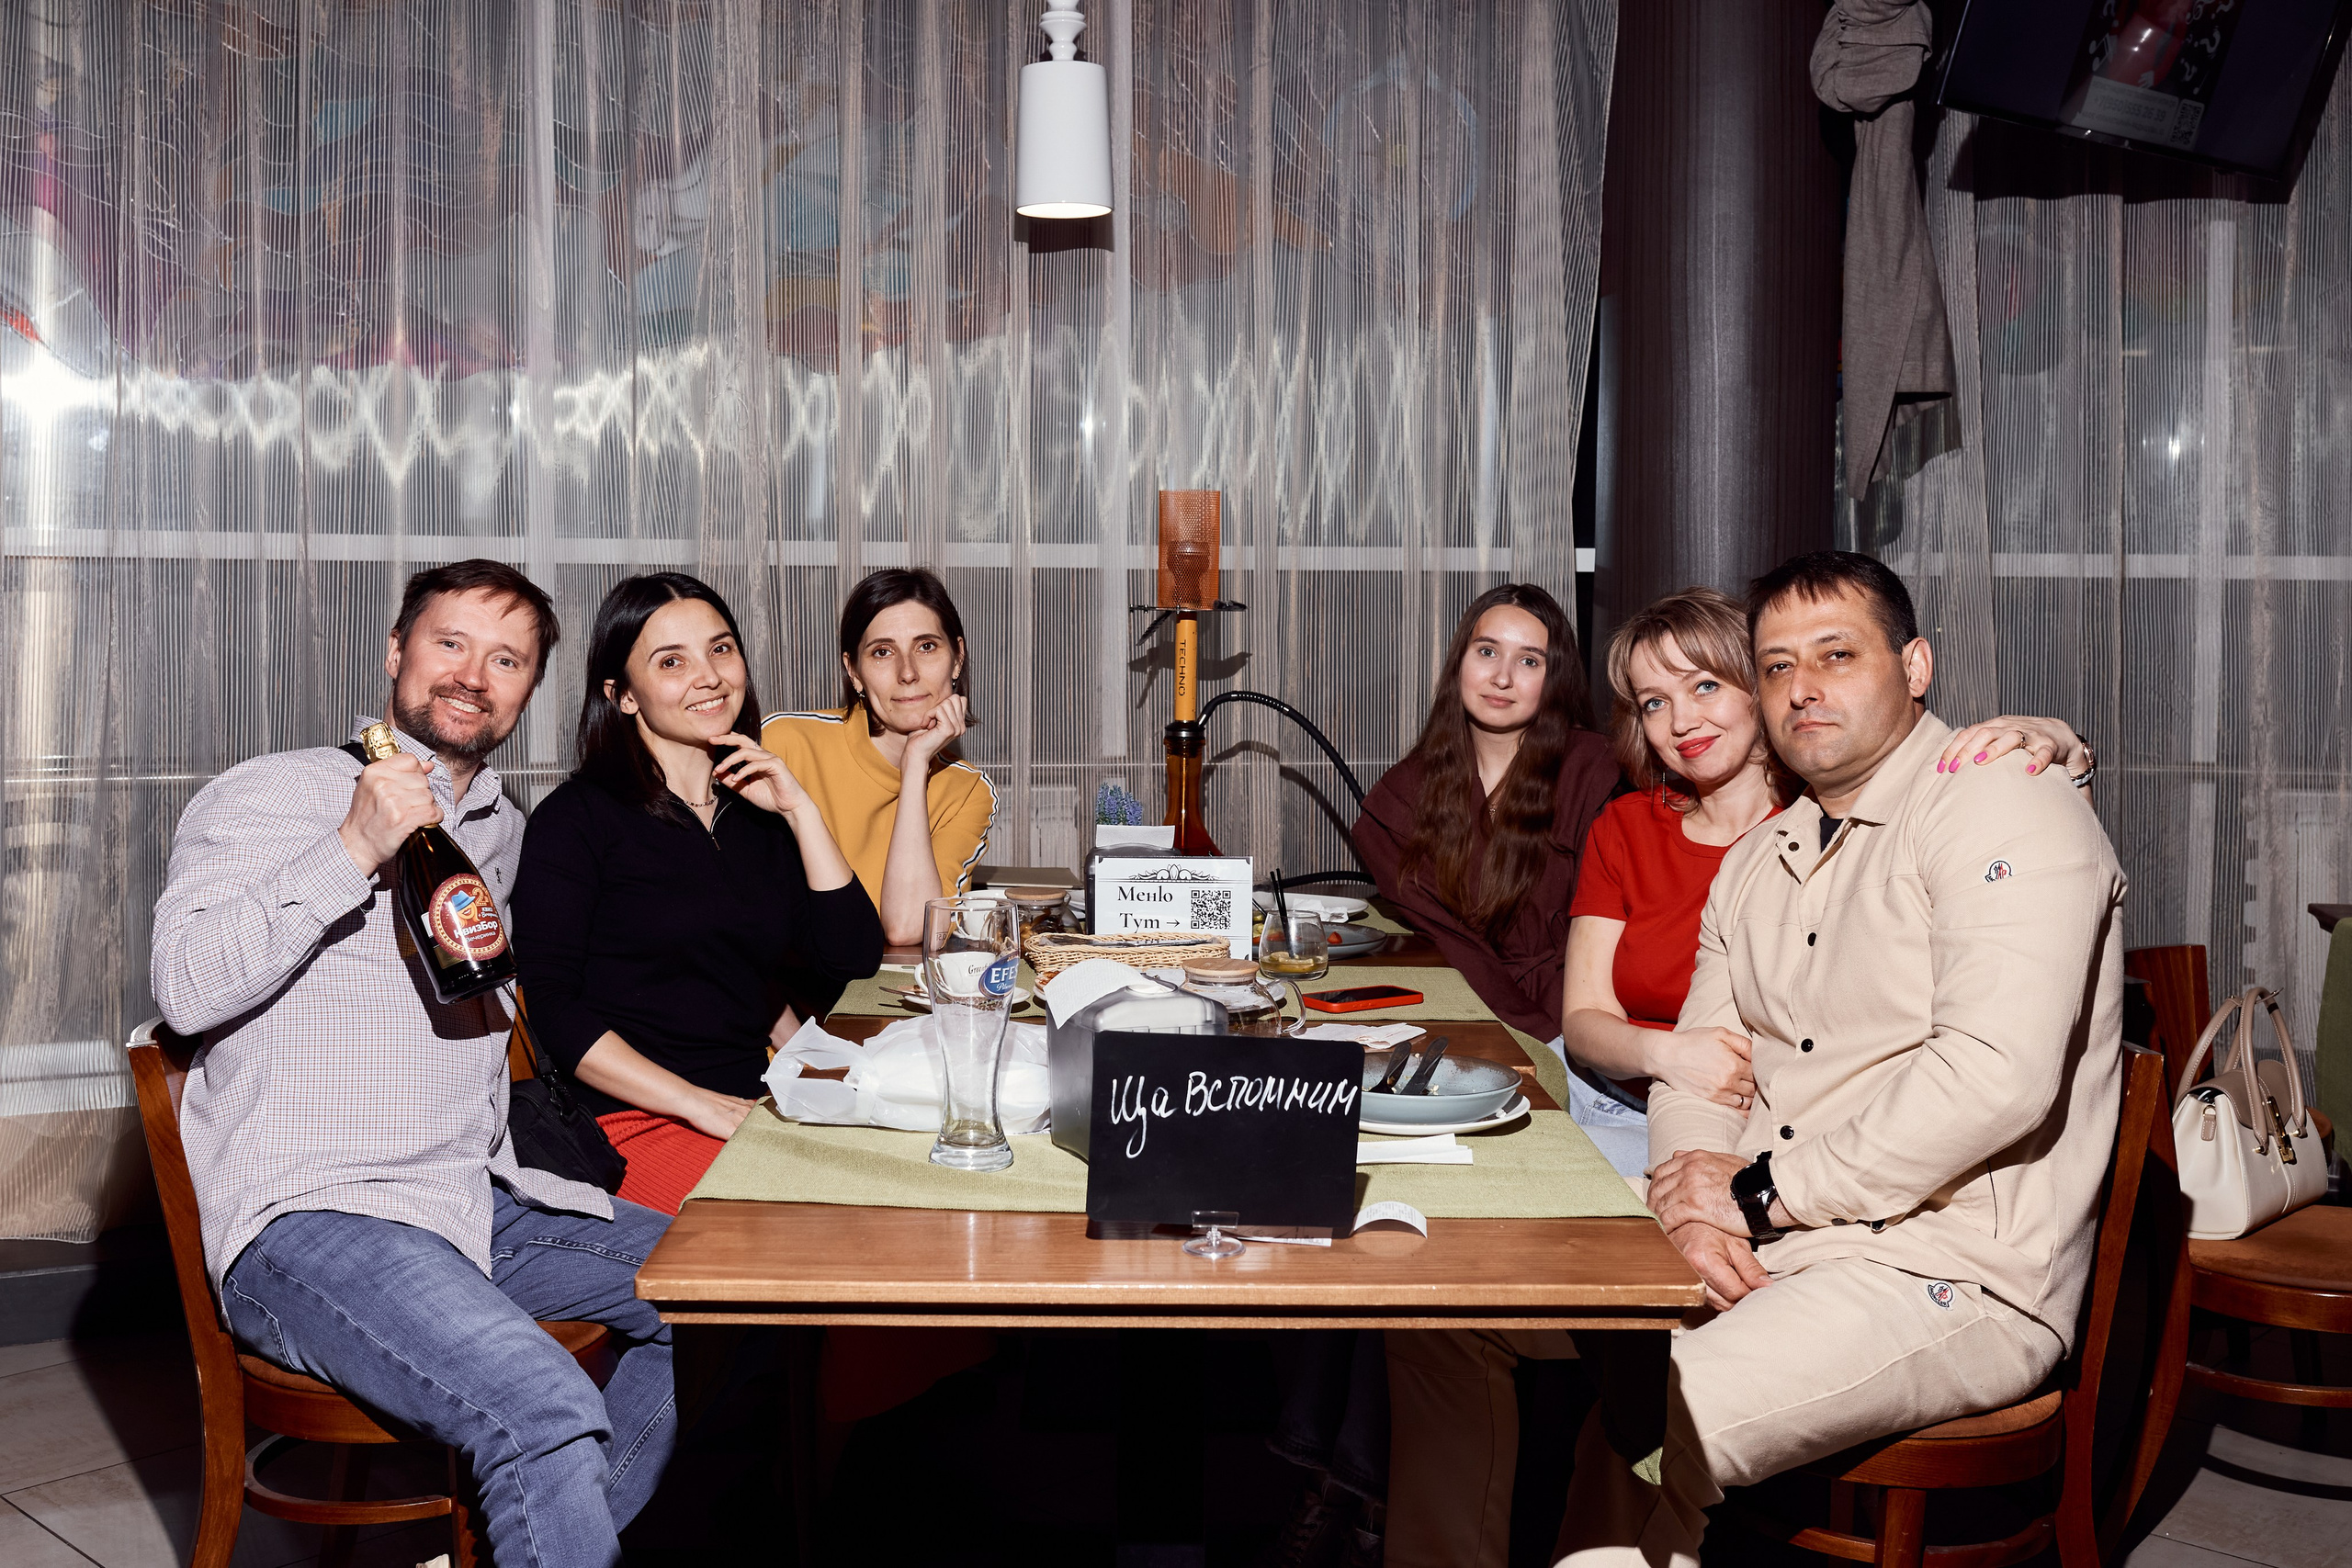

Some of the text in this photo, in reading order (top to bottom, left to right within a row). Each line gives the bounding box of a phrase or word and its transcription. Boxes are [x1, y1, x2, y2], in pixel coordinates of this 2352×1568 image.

[1178, 639, 1186, 696] TECHNO
[1117, 885, 1173, 903] Меню
[1119, 912, 1160, 933] Тут
[1110, 1075, 1179, 1159] Ща
